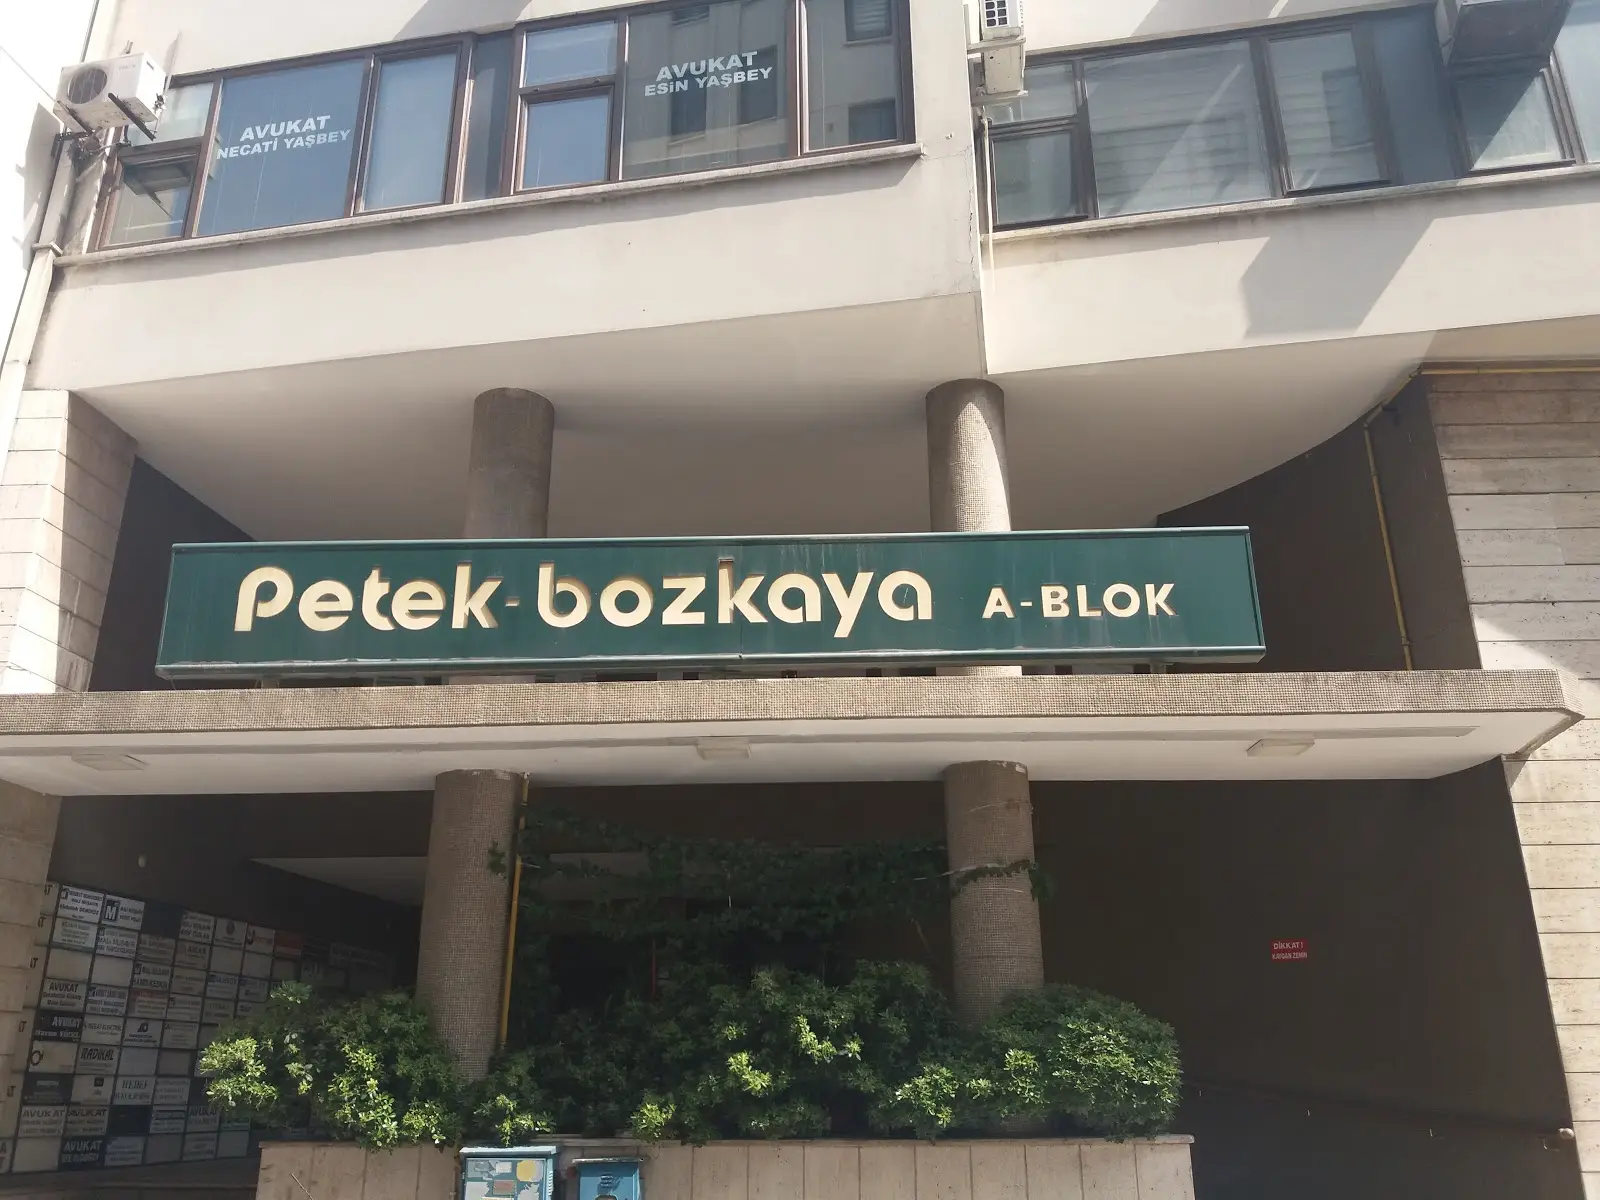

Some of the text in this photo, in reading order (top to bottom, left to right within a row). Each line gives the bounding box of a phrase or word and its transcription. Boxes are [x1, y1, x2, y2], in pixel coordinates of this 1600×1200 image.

[656, 51, 758, 82] AVUKAT
[695, 66, 773, 89] YAŞBEY
[239, 115, 331, 142] AVUKAT
[216, 129, 351, 160] NECATİ YAŞBEY
[48, 982, 79, 993] AVUKAT
[22, 1109, 66, 1118] AVUKAT
[67, 1108, 108, 1117] AVUKAT
[64, 1140, 104, 1152] AVUKAT
